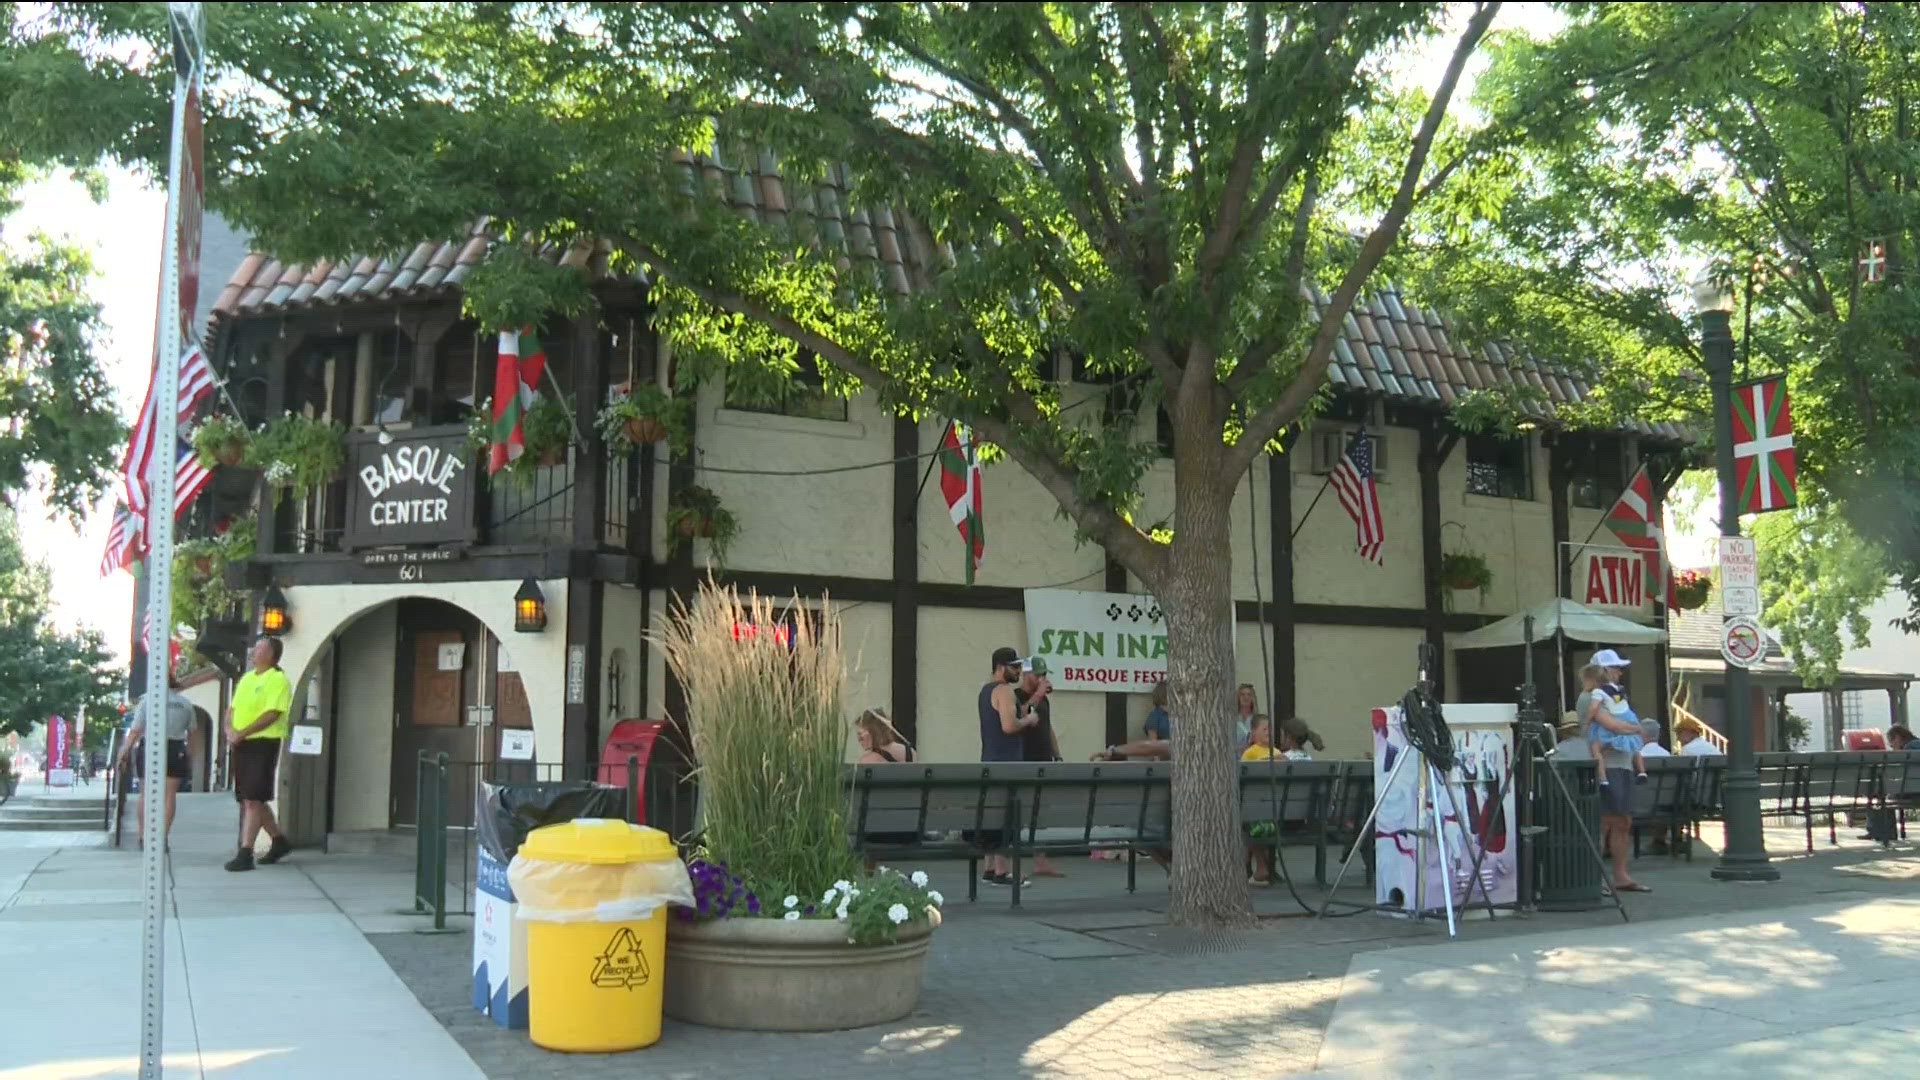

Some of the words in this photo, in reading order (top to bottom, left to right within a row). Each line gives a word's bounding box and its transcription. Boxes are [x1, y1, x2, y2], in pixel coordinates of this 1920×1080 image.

[360, 445, 465, 498] BASQUE
[370, 499, 448, 526] CENTER
[388, 553, 399, 562] TO
[403, 552, 418, 561] THE
[421, 550, 451, 560] PUBLIC
[1729, 543, 1745, 554] NO
[1722, 554, 1753, 565] PARKING
[400, 564, 423, 580] 601
[1586, 555, 1642, 607] ATM
[1038, 628, 1104, 657] SAN
[1064, 667, 1128, 684] BASQUE
[604, 966, 641, 974] RECYCLE
